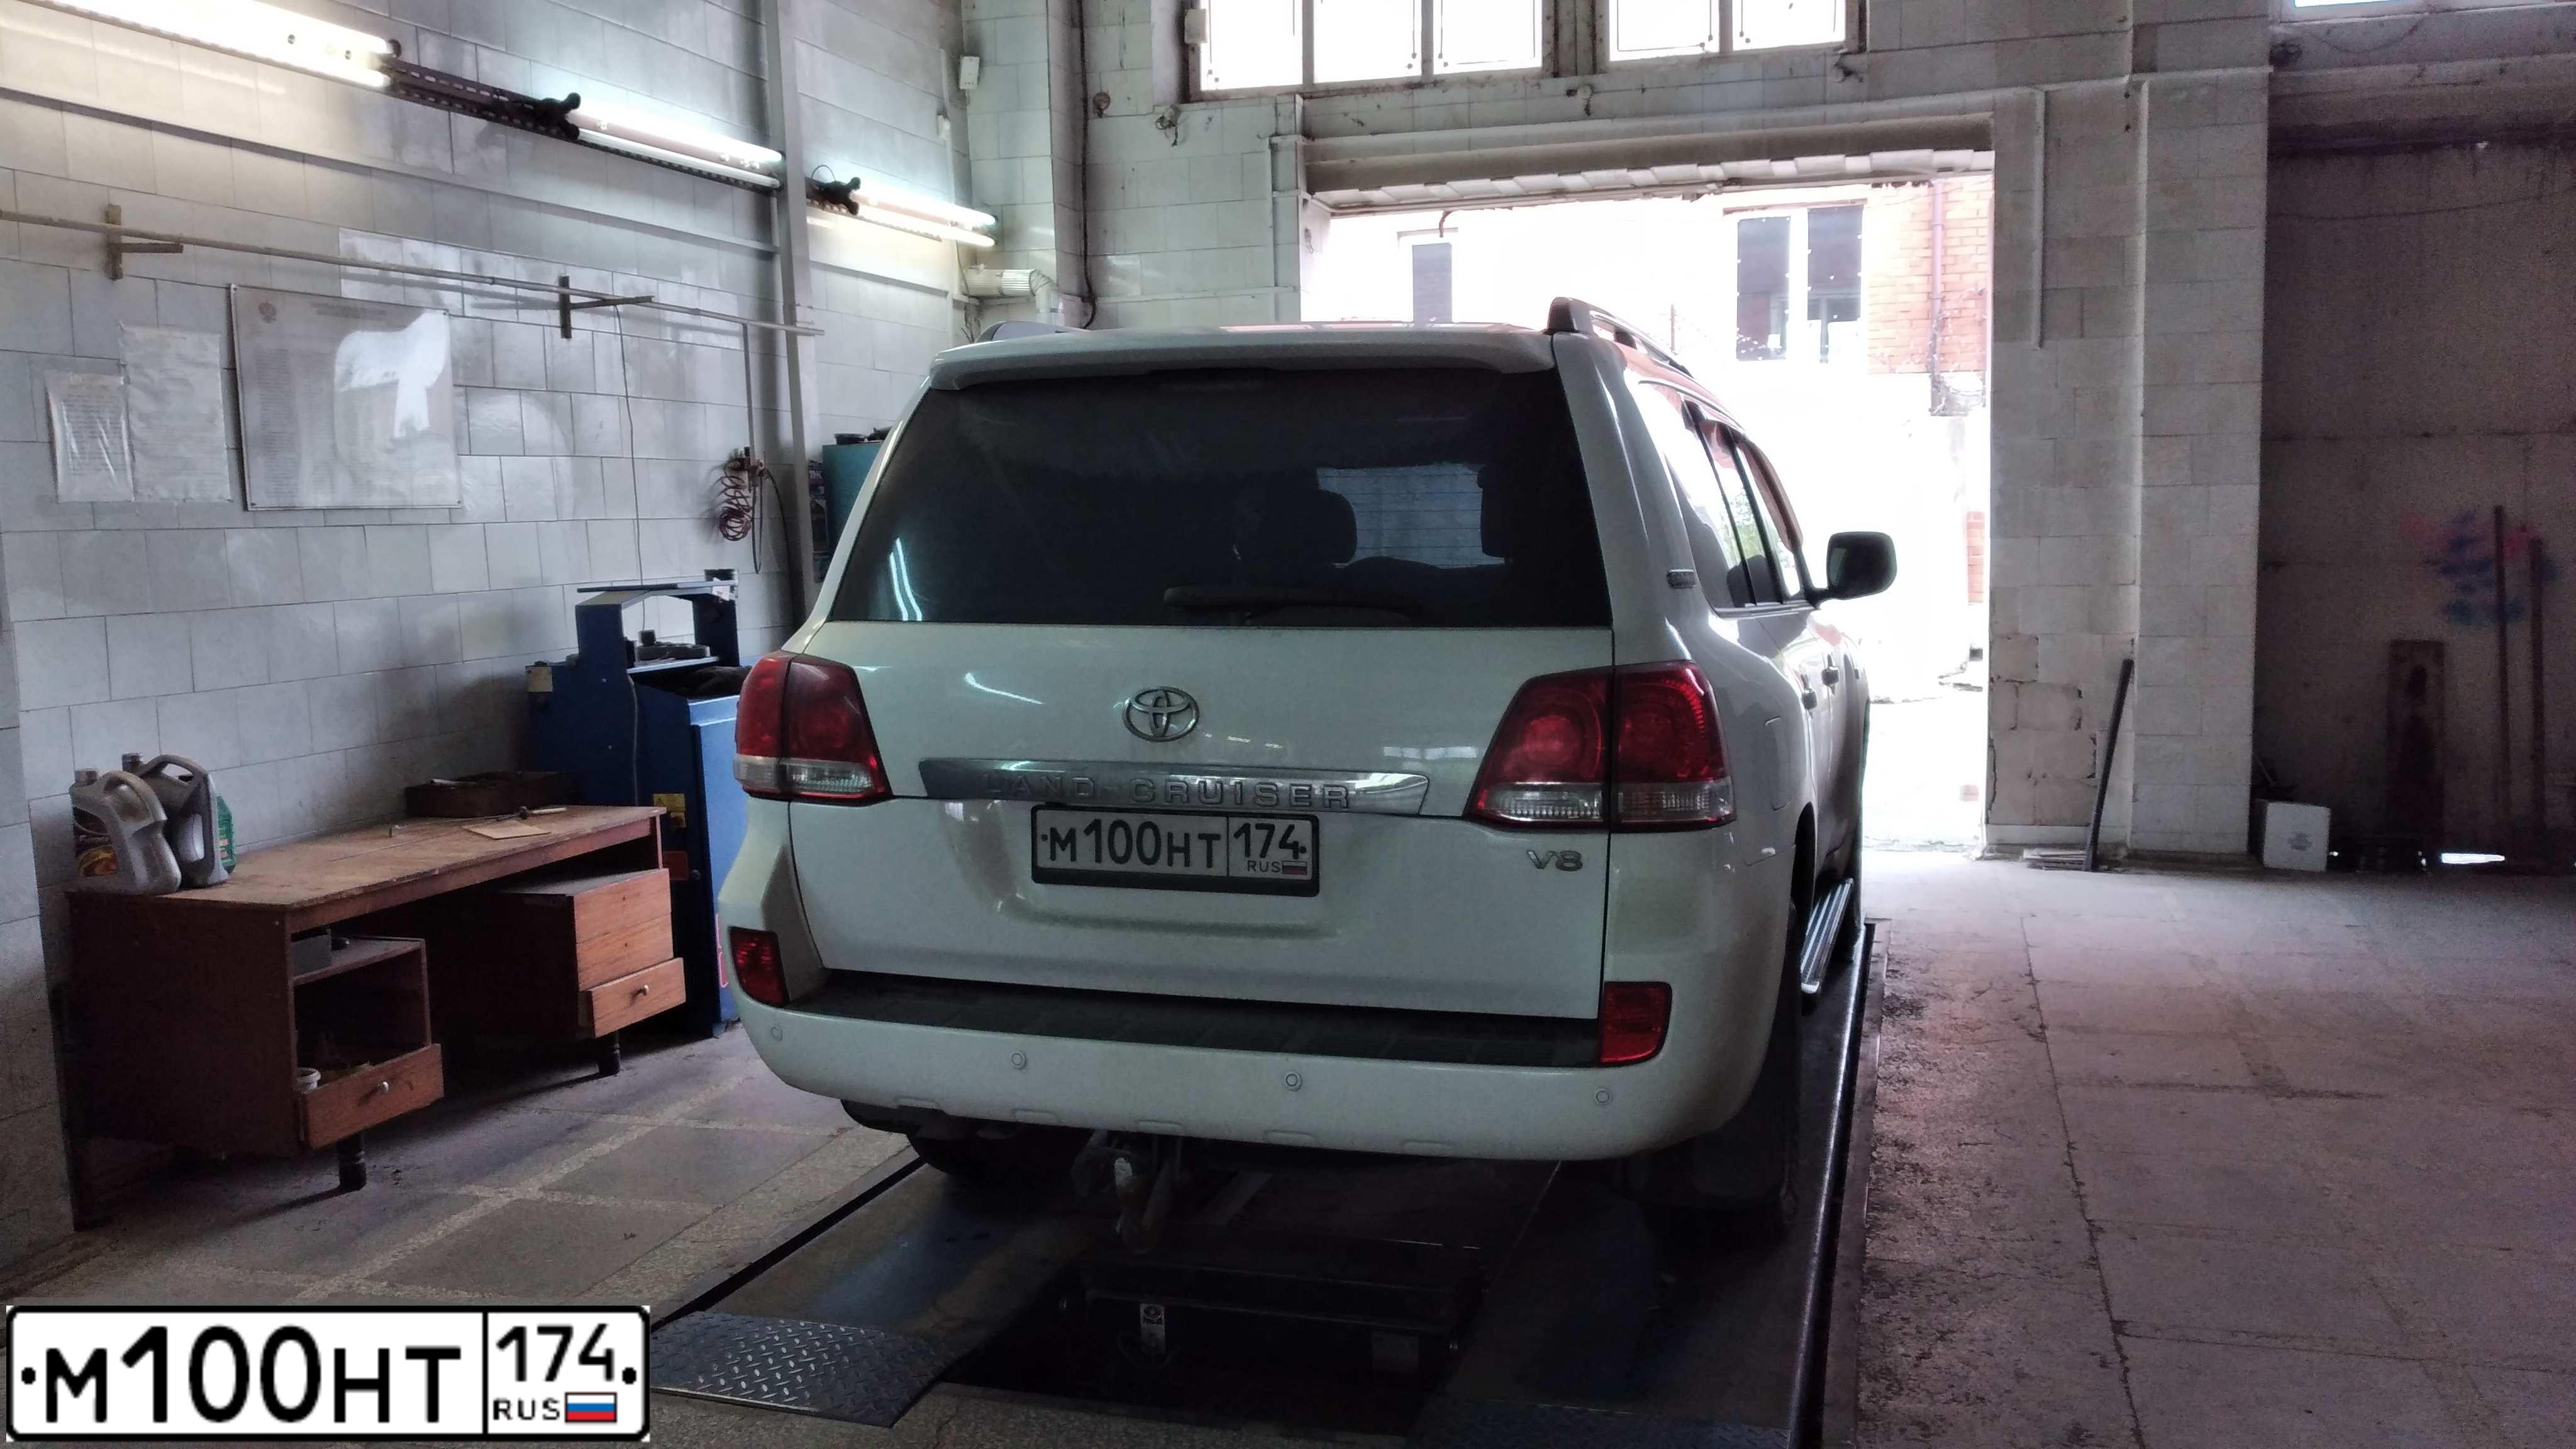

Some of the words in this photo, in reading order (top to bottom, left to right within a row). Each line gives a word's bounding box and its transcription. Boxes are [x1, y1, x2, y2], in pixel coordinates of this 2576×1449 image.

[982, 773, 1096, 799] LAND
[1131, 777, 1351, 810] CRUISER
[1233, 822, 1301, 860] 174
[1246, 860, 1281, 874] RUS
[1526, 850, 1584, 872] V8
